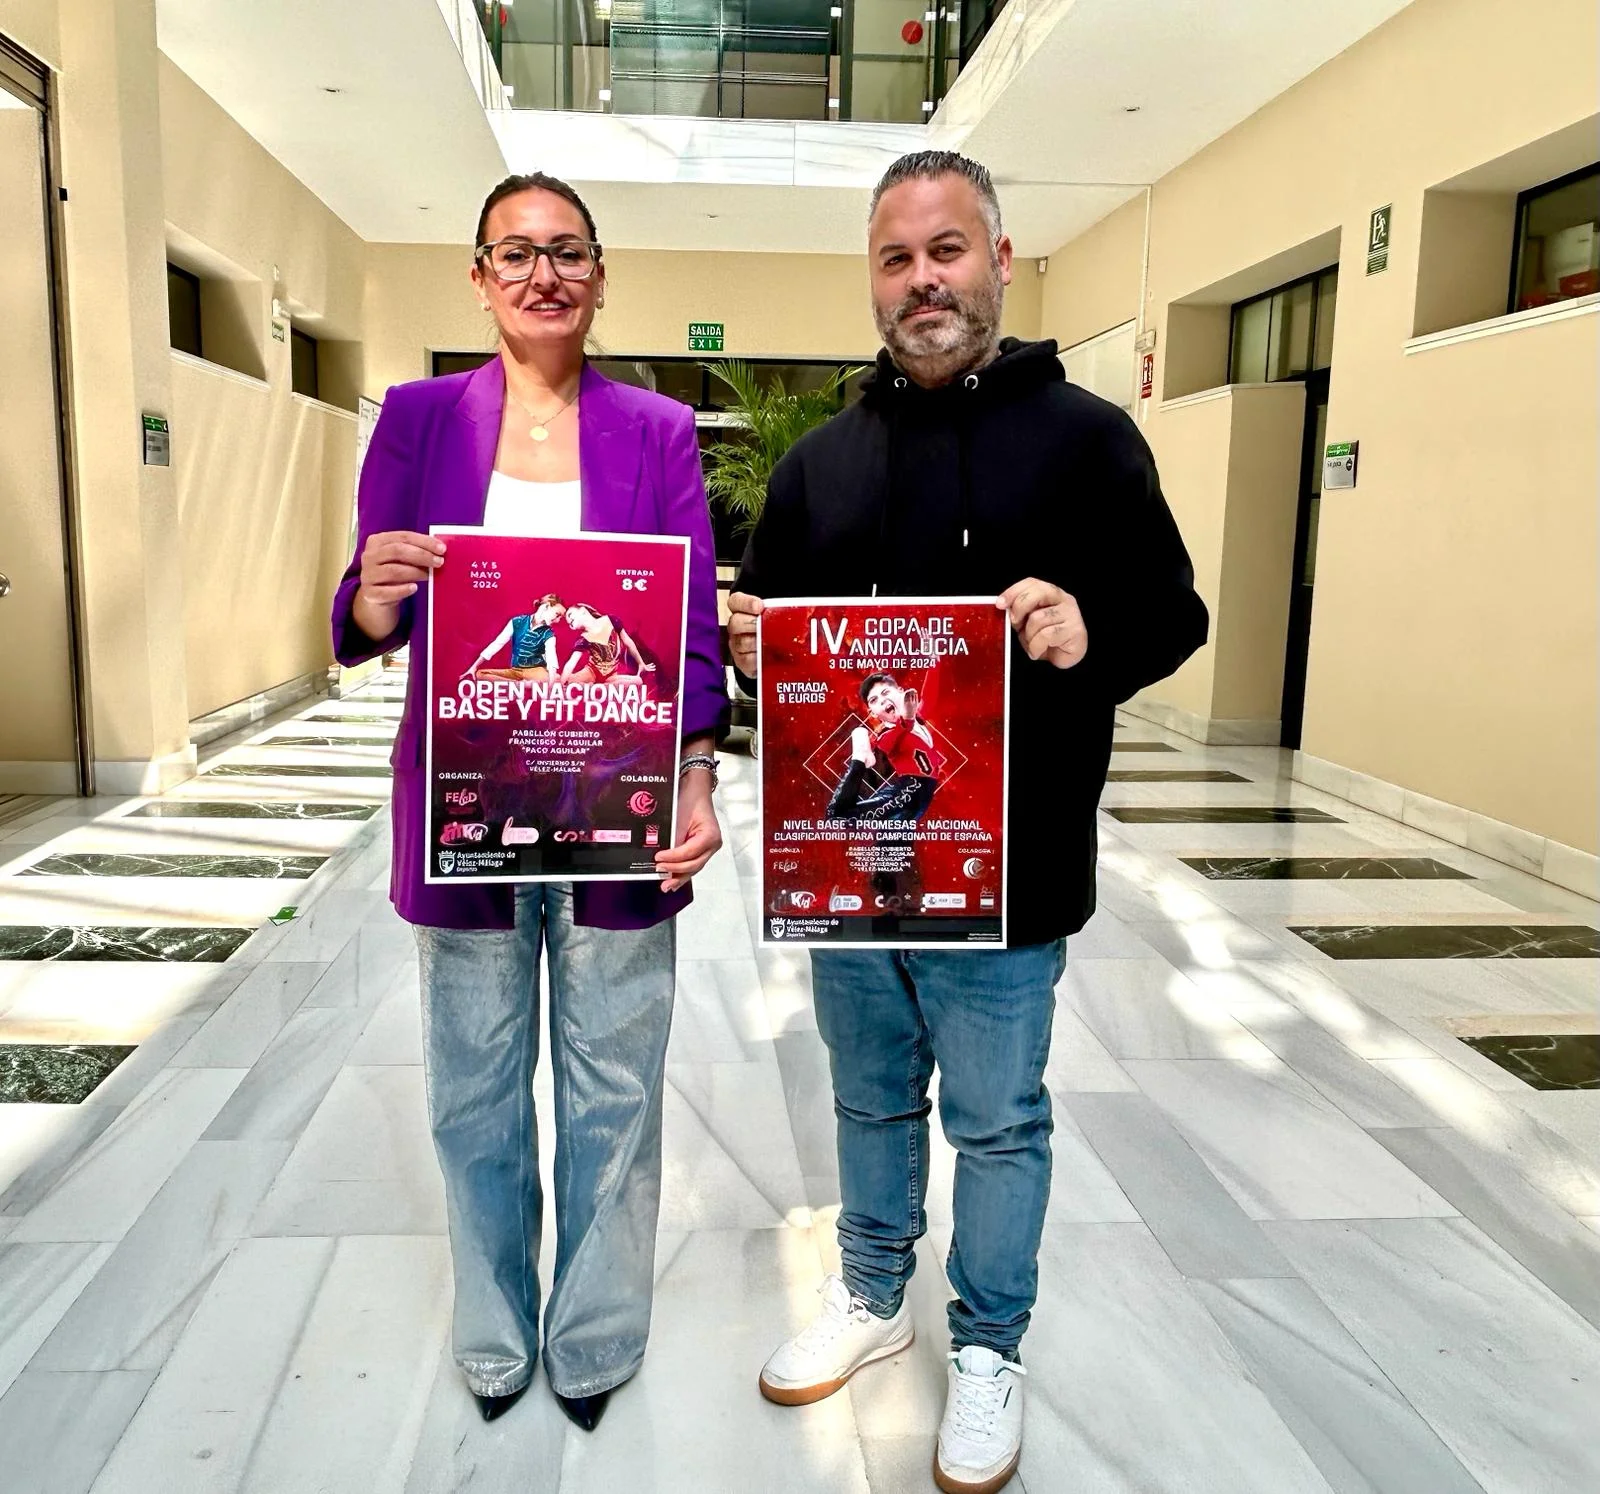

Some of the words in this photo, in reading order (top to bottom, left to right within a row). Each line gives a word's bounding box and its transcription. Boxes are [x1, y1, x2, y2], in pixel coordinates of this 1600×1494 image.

[690, 325, 722, 336] SALIDA
[689, 338, 723, 349] EXIT
[471, 561, 478, 569] 4
[481, 561, 488, 569] Y
[491, 561, 498, 569] 5
[470, 571, 502, 580] MAYO
[615, 568, 655, 577] ENTRADA
[472, 580, 499, 589] 2024
[622, 578, 648, 592] 8€
[864, 616, 921, 637] COPA
[927, 616, 955, 636] DE
[810, 617, 849, 656] IV
[828, 658, 836, 670] 3
[839, 658, 854, 669] DE
[856, 658, 889, 670] MAYO
[892, 658, 908, 669] DE
[910, 657, 937, 670] 2024
[457, 679, 526, 702] OPEN
[531, 681, 655, 704] NACIONAL
[776, 682, 829, 693] ENTRADA
[788, 693, 826, 704] EUROS
[439, 696, 510, 721] BASE
[515, 698, 535, 721] Y
[540, 699, 580, 722] FIT
[584, 700, 673, 724] DANCE
[512, 729, 557, 737] PABELLÓN
[508, 738, 557, 746] FRANCISCO
[783, 820, 814, 830] NIVEL
[817, 820, 847, 830] BASE
[855, 820, 917, 830] PROMESAS
[927, 820, 983, 830] NACIONAL
[774, 832, 847, 841] CLASIFICATORIO
[848, 832, 874, 841] PARA
[876, 832, 938, 841] CAMPEONATO
[940, 832, 952, 841] DE
[954, 831, 993, 842] ESPAÑA
